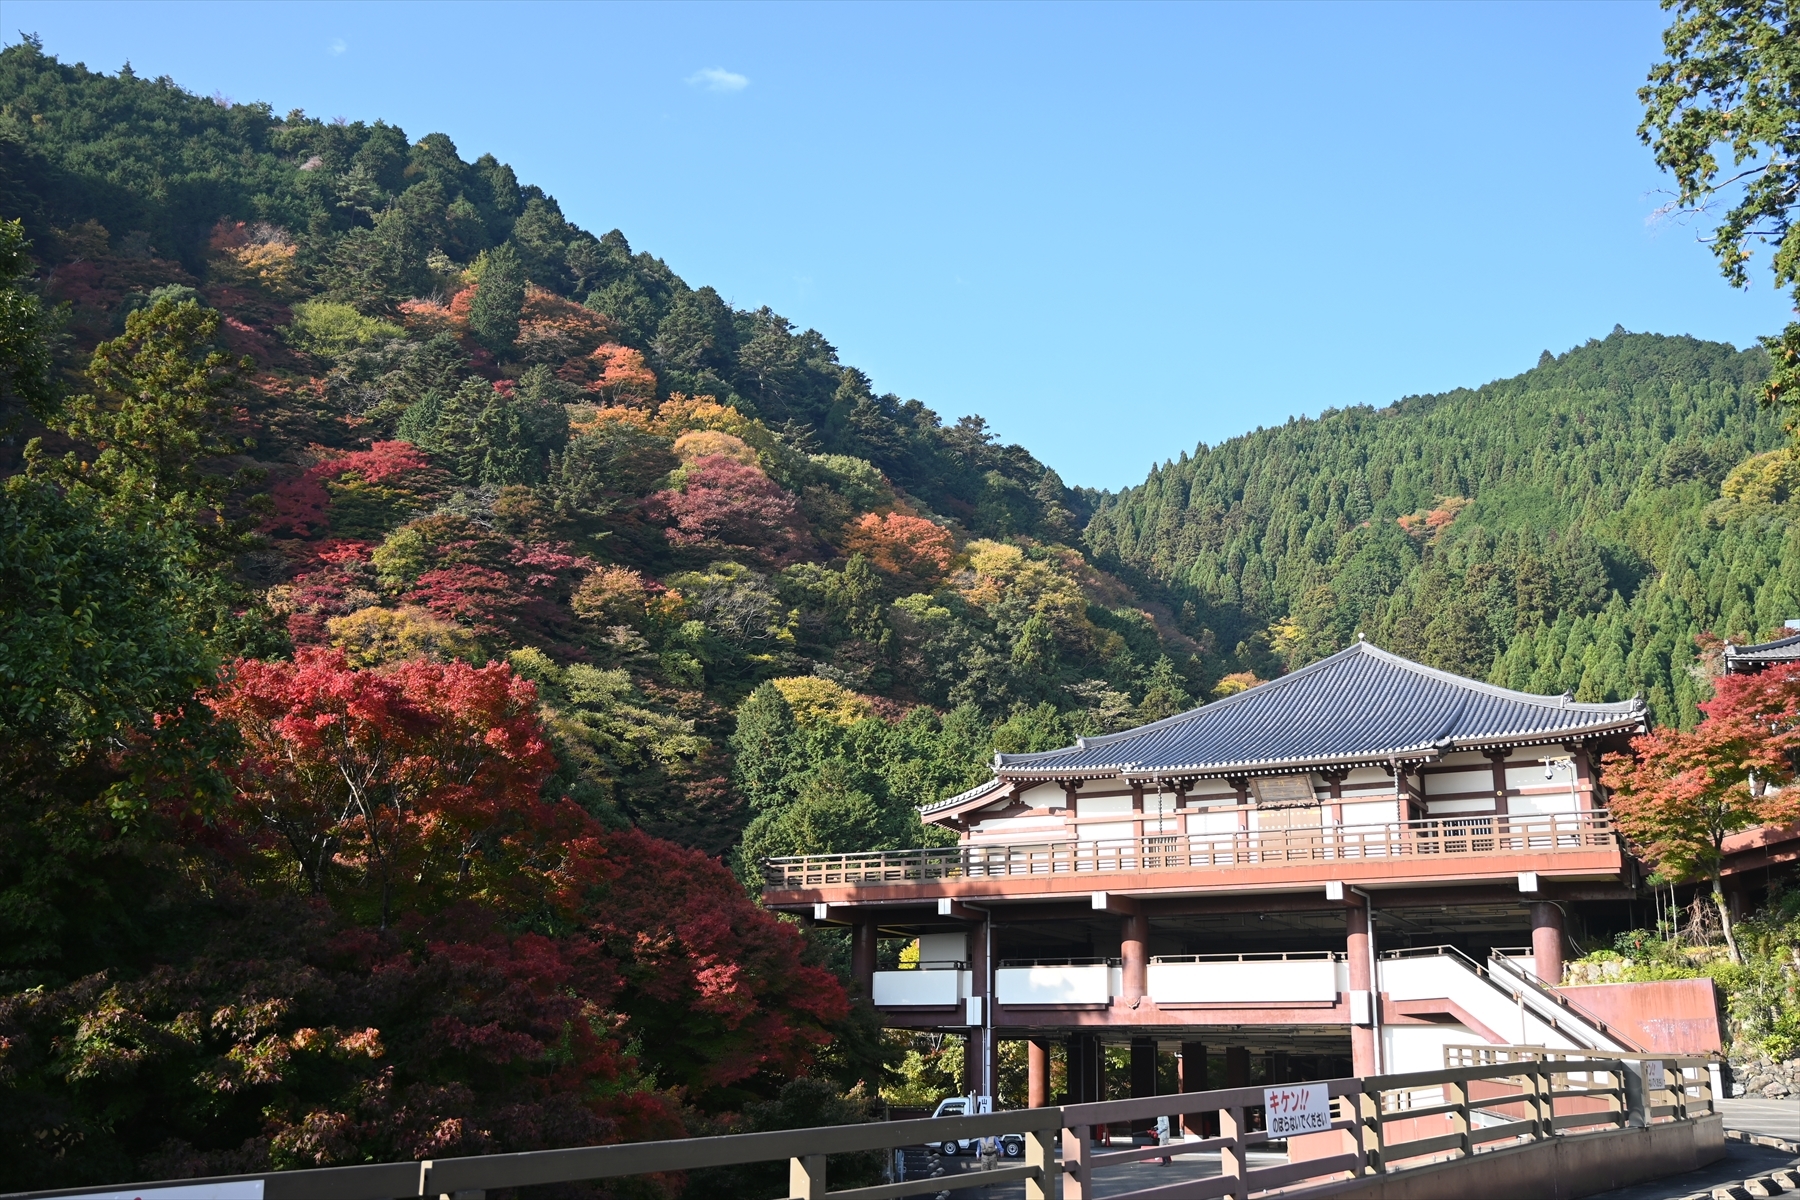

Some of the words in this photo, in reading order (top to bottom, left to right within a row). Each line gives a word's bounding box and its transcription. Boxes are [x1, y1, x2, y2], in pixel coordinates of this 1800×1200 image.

[1269, 1088, 1310, 1115] キケン!!
[1272, 1112, 1328, 1133] のぼらないでください
